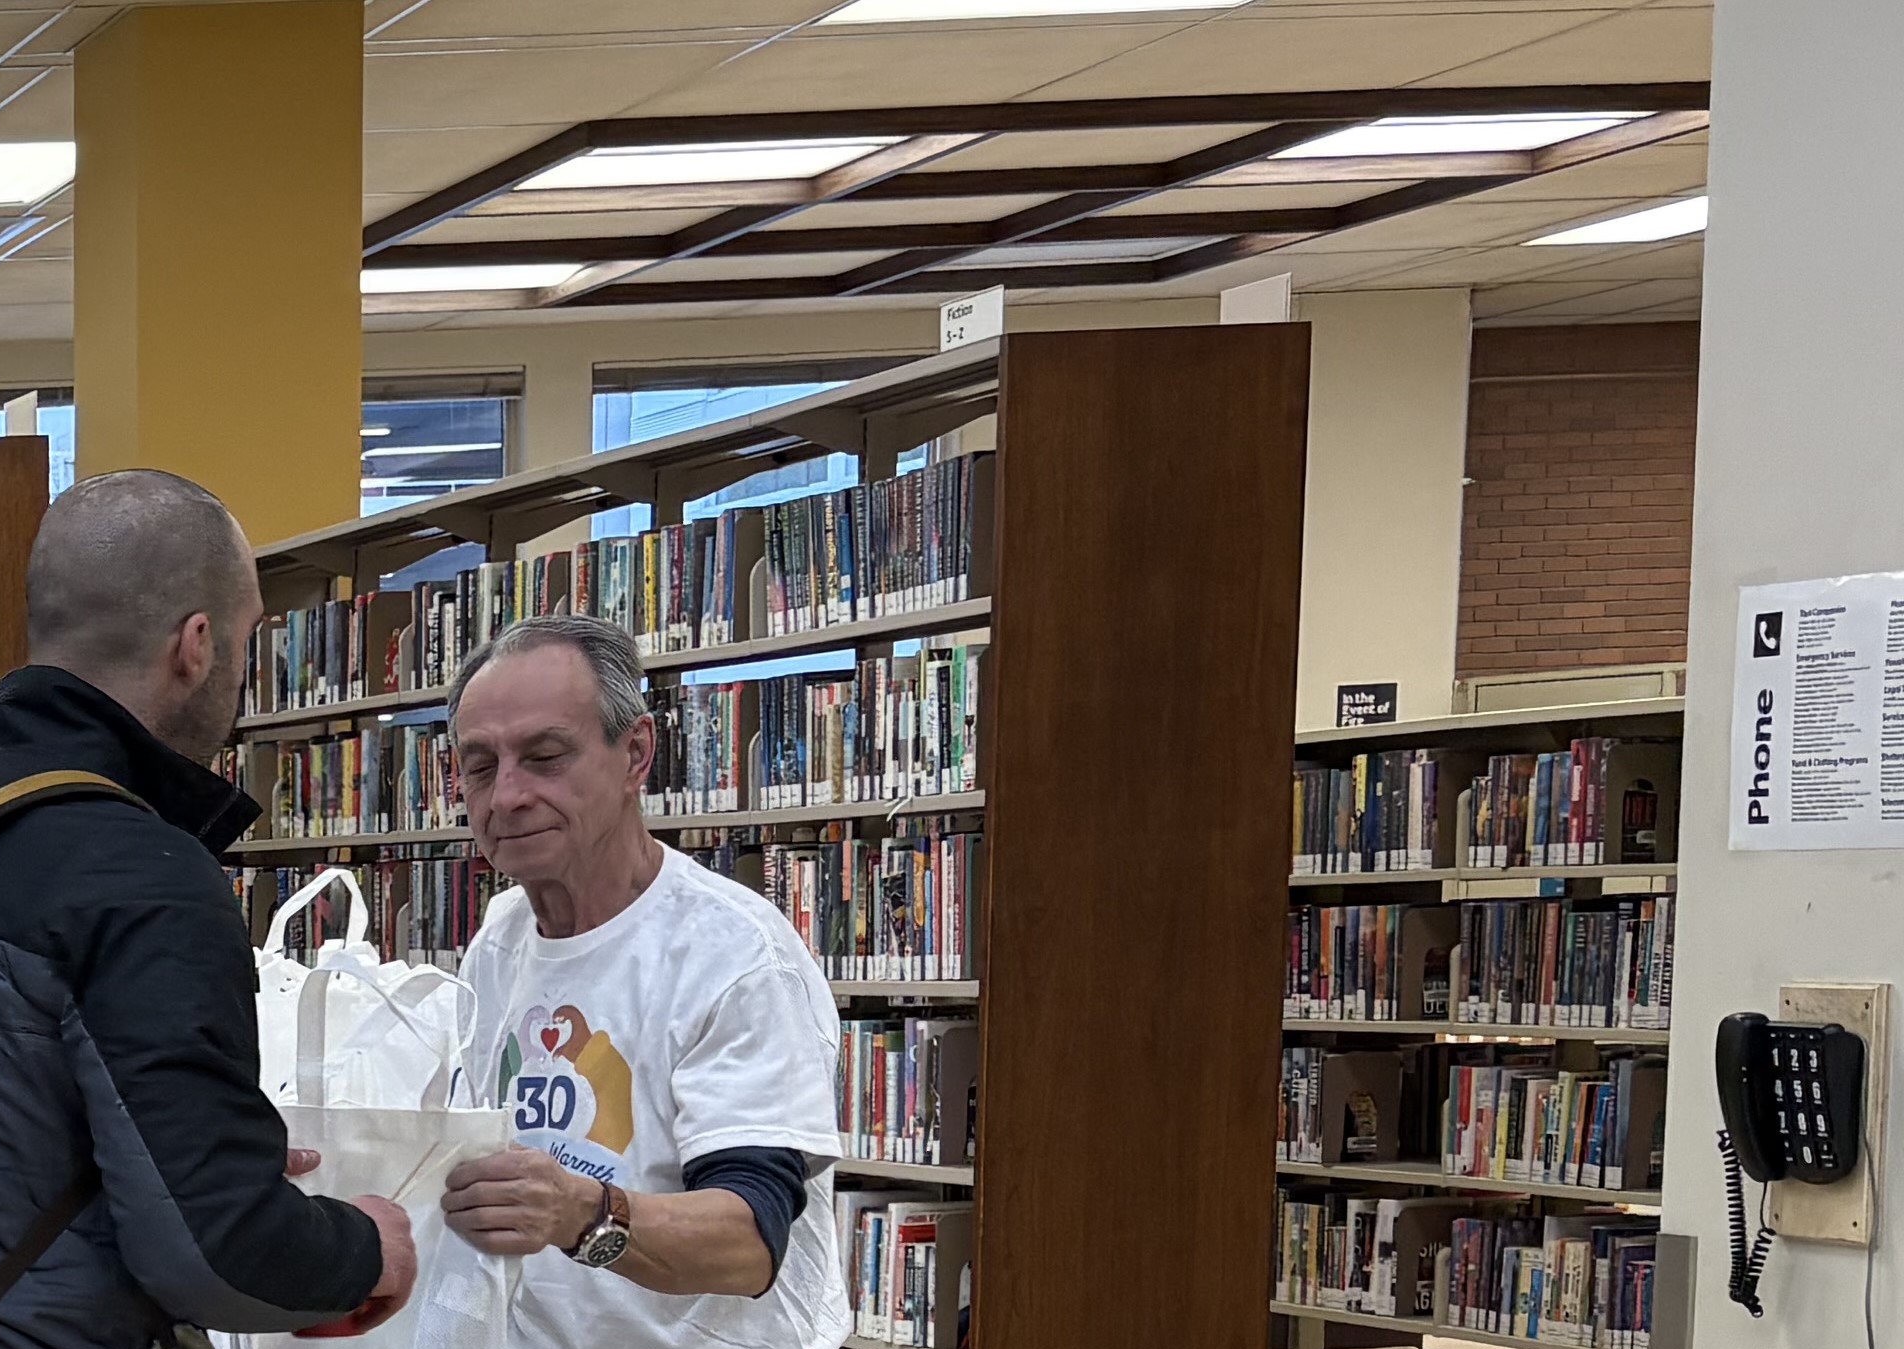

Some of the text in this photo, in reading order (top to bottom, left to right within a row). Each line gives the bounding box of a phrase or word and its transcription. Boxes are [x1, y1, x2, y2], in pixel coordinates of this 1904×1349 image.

[1747, 688, 1774, 825] Phone
[1790, 1048, 1799, 1067] 2
[515, 1075, 576, 1131] 30
